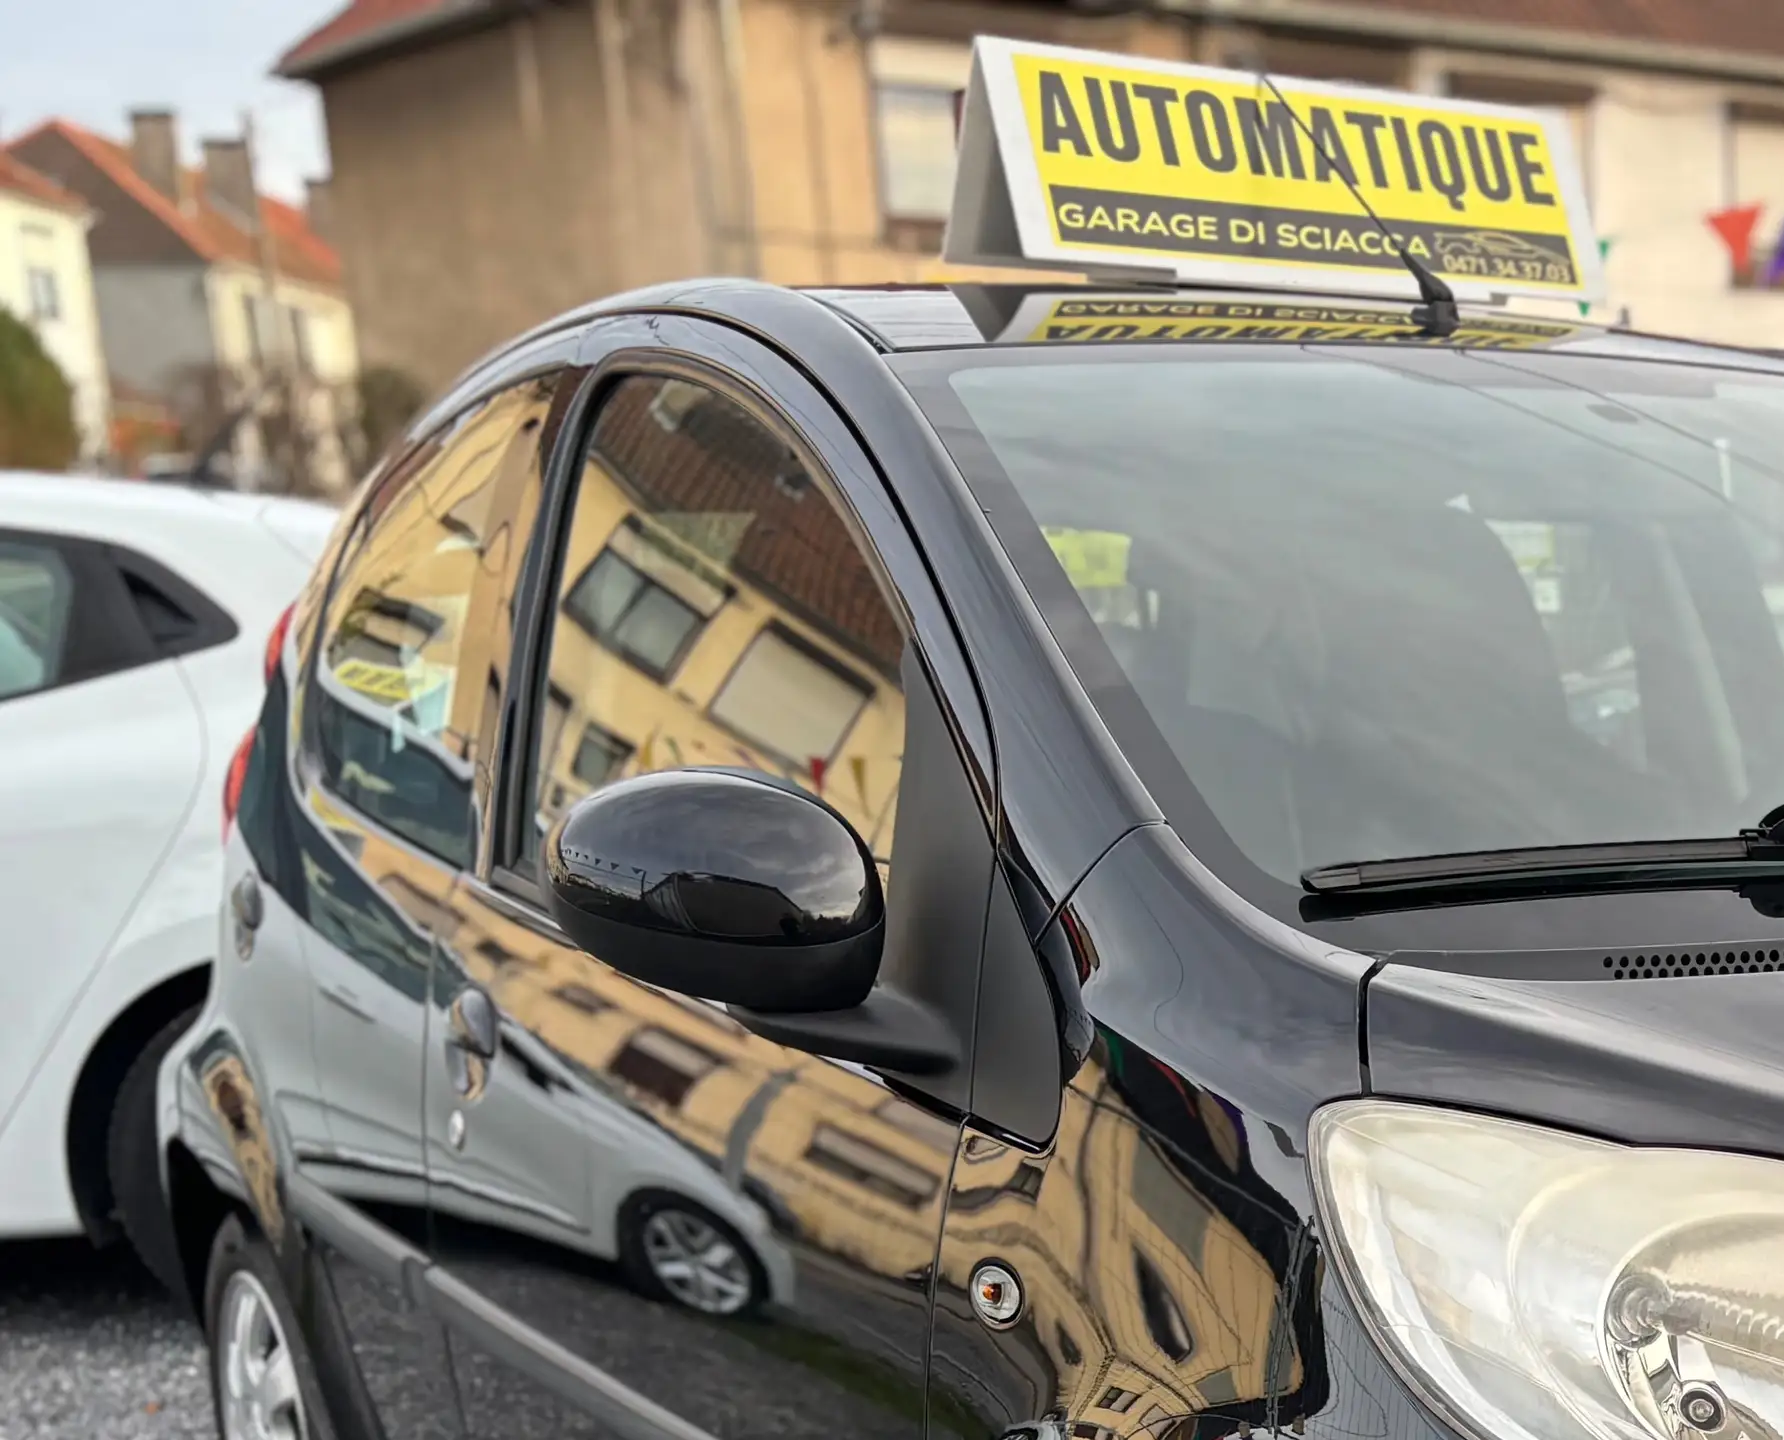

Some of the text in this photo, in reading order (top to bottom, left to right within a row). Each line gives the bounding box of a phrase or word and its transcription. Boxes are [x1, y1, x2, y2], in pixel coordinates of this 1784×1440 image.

[1038, 70, 1556, 209] AUTOMATIQUE
[1058, 202, 1431, 260] GARAGE DI SCIACCA
[1442, 254, 1571, 283] 0471.34.37.03
